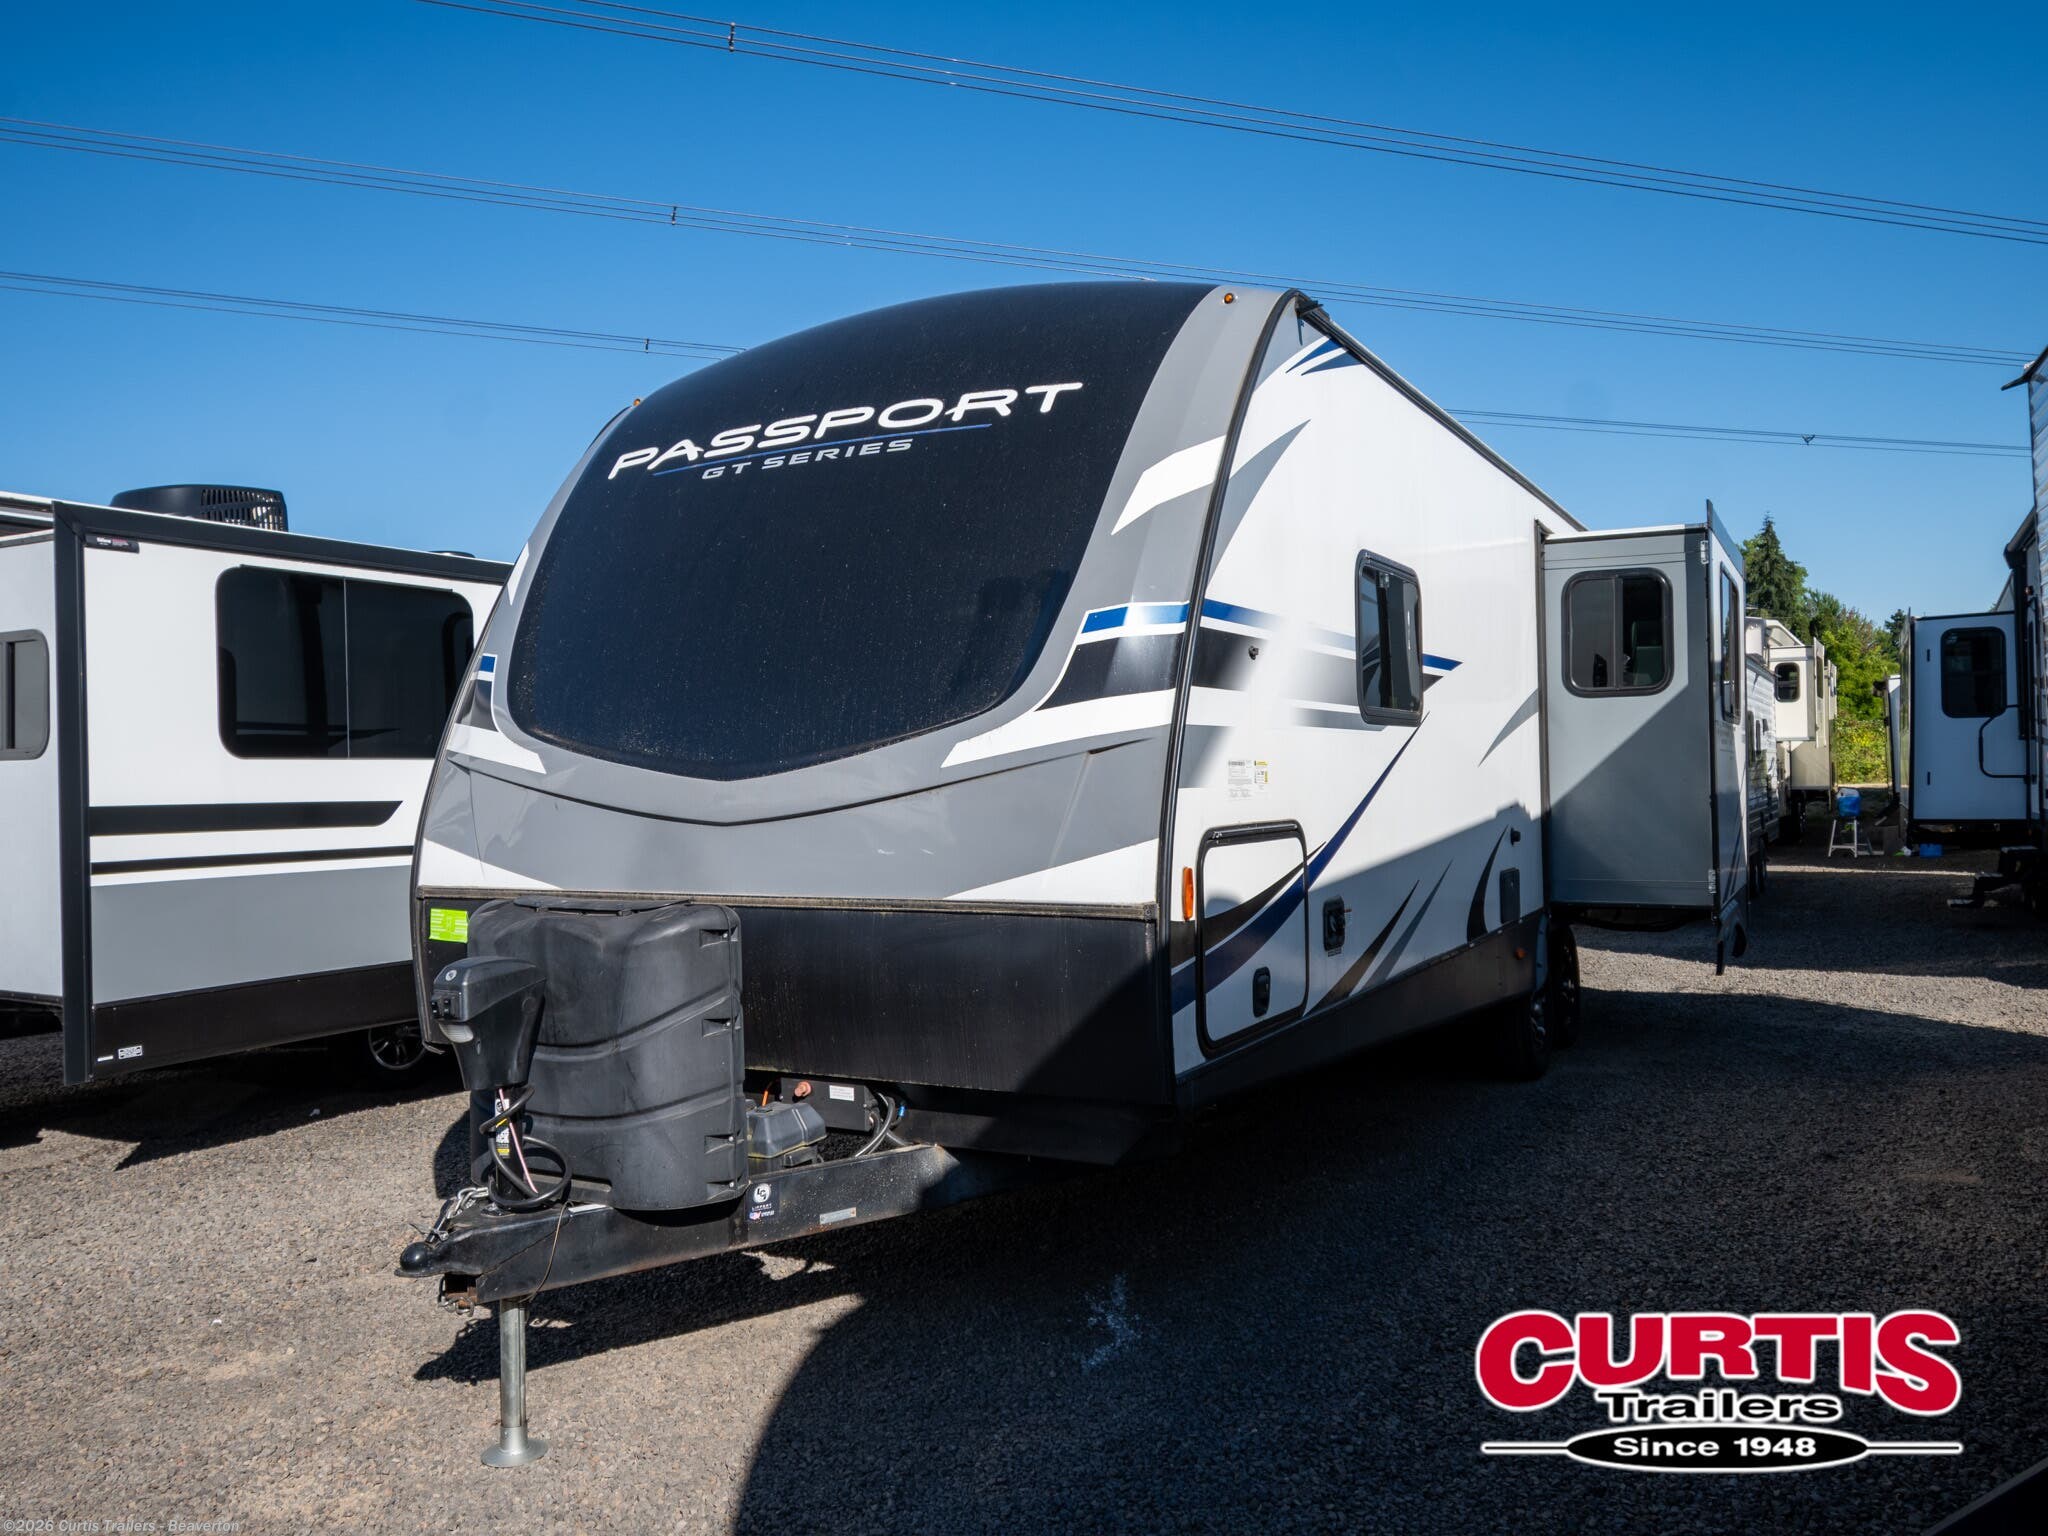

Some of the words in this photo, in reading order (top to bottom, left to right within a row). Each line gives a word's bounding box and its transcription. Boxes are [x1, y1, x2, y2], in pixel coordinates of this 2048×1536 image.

[607, 382, 1083, 480] PASSPORT
[701, 461, 752, 480] GT
[761, 437, 914, 470] SERIES
